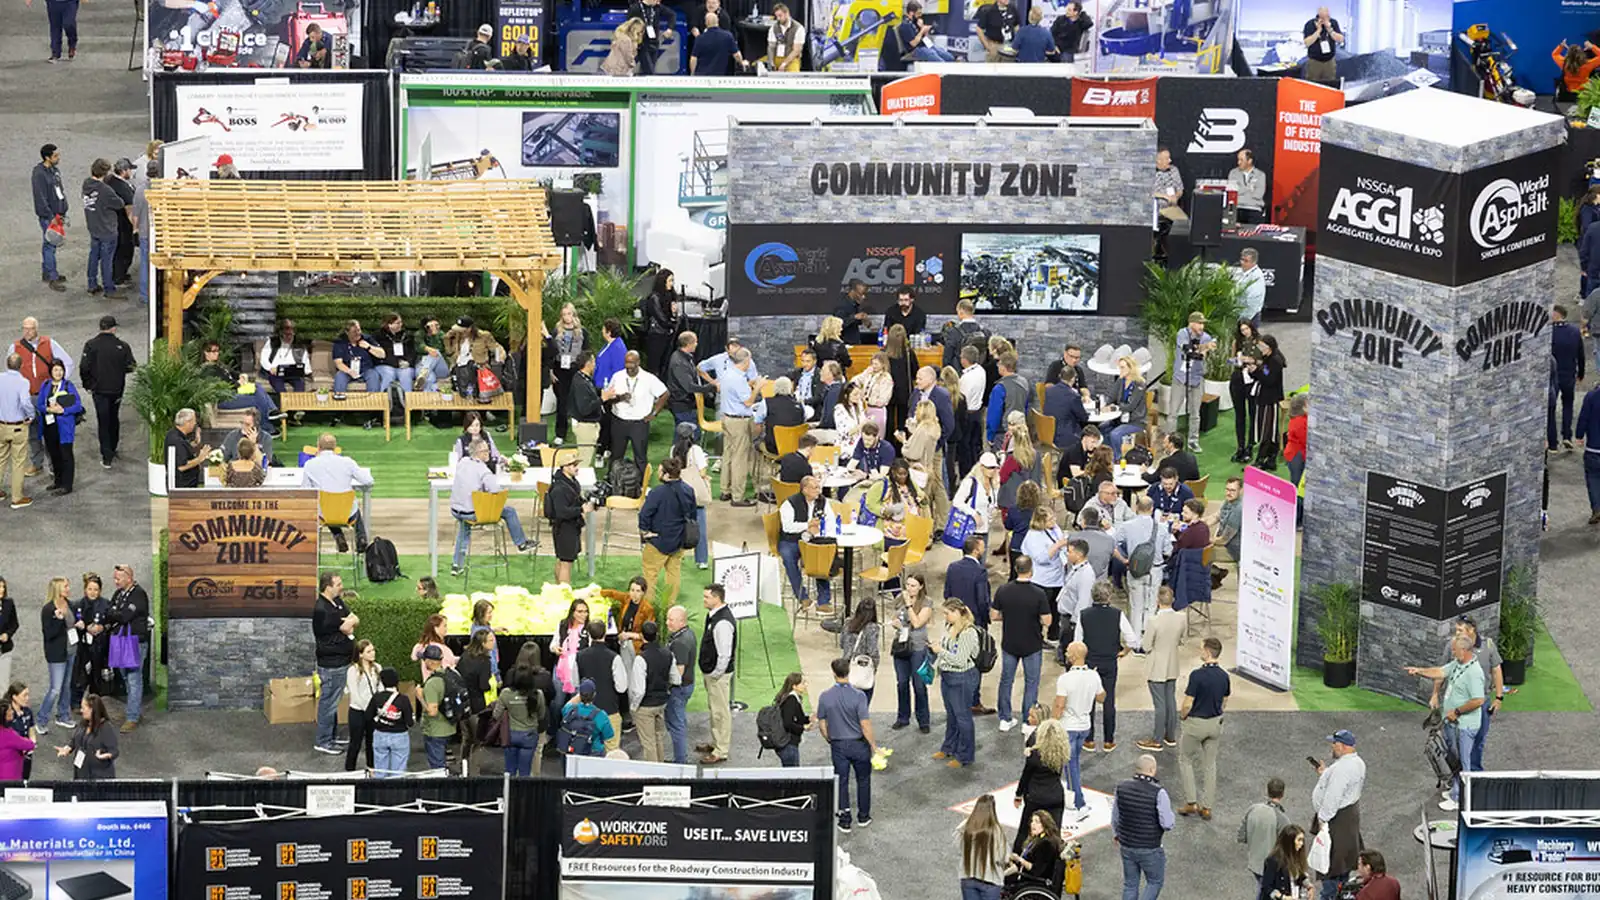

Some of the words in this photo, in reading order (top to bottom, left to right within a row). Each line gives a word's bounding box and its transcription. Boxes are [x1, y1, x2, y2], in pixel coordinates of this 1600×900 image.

[501, 41, 539, 57] RH
[1299, 99, 1317, 112] THE
[229, 118, 257, 126] BOSS
[1279, 111, 1321, 125] FOUNDATI
[1285, 126, 1297, 138] OF
[1299, 127, 1321, 140] EVER
[1283, 139, 1321, 153] INDUSTR
[811, 162, 992, 197] COMMUNITY
[1000, 163, 1078, 197] ZONE
[1357, 176, 1395, 197] NSSGA
[1519, 174, 1549, 194] World
[1528, 191, 1537, 201] of
[1328, 186, 1413, 239] AGG1
[1481, 195, 1549, 237] Asphalt
[1326, 223, 1374, 242] AGGREGATES
[1375, 235, 1412, 251] ACADEMY
[1414, 244, 1421, 253] &
[1421, 245, 1443, 259] EXPO
[1481, 249, 1500, 261] SHOW
[1506, 233, 1546, 253] CONFERENCE
[866, 247, 900, 257] NSSGA
[841, 246, 916, 285] AGG1
[1317, 299, 1443, 358] COMMUNITY
[1455, 301, 1550, 362] COMMUNITY
[1351, 329, 1403, 369] ZONE
[1483, 332, 1522, 371] ZONE
[211, 500, 249, 510] WELCOME
[252, 500, 262, 510] TO
[265, 500, 279, 510] THE
[179, 514, 307, 551] COMMUNITY
[216, 541, 269, 564] ZONE
[729, 600, 753, 609] EPTION
[600, 820, 668, 834] WORKZONE
[683, 827, 709, 841] USE
[710, 828, 732, 841] IT...
[734, 828, 767, 842] SAVE
[769, 829, 808, 843] LIVES!
[9, 838, 75, 849] Materials
[79, 837, 104, 850] Co.,
[108, 837, 135, 849] Ltd.
[600, 834, 668, 847] SAFETY.ORG
[32, 850, 52, 859] parts
[53, 849, 103, 858] manufacturer
[104, 849, 113, 857] in
[114, 849, 135, 857] China
[568, 862, 590, 872] FREE
[592, 862, 637, 873] Resources
[638, 863, 651, 873] for
[653, 863, 668, 873] the
[669, 864, 710, 876] Roadway
[712, 865, 770, 875] Construction
[771, 866, 809, 878] Industry
[1515, 872, 1562, 881] RESOURCE
[1565, 872, 1584, 881] FOR
[1507, 884, 1536, 893] HEAVY
[1538, 884, 1600, 893] CONSTRUCTIO
